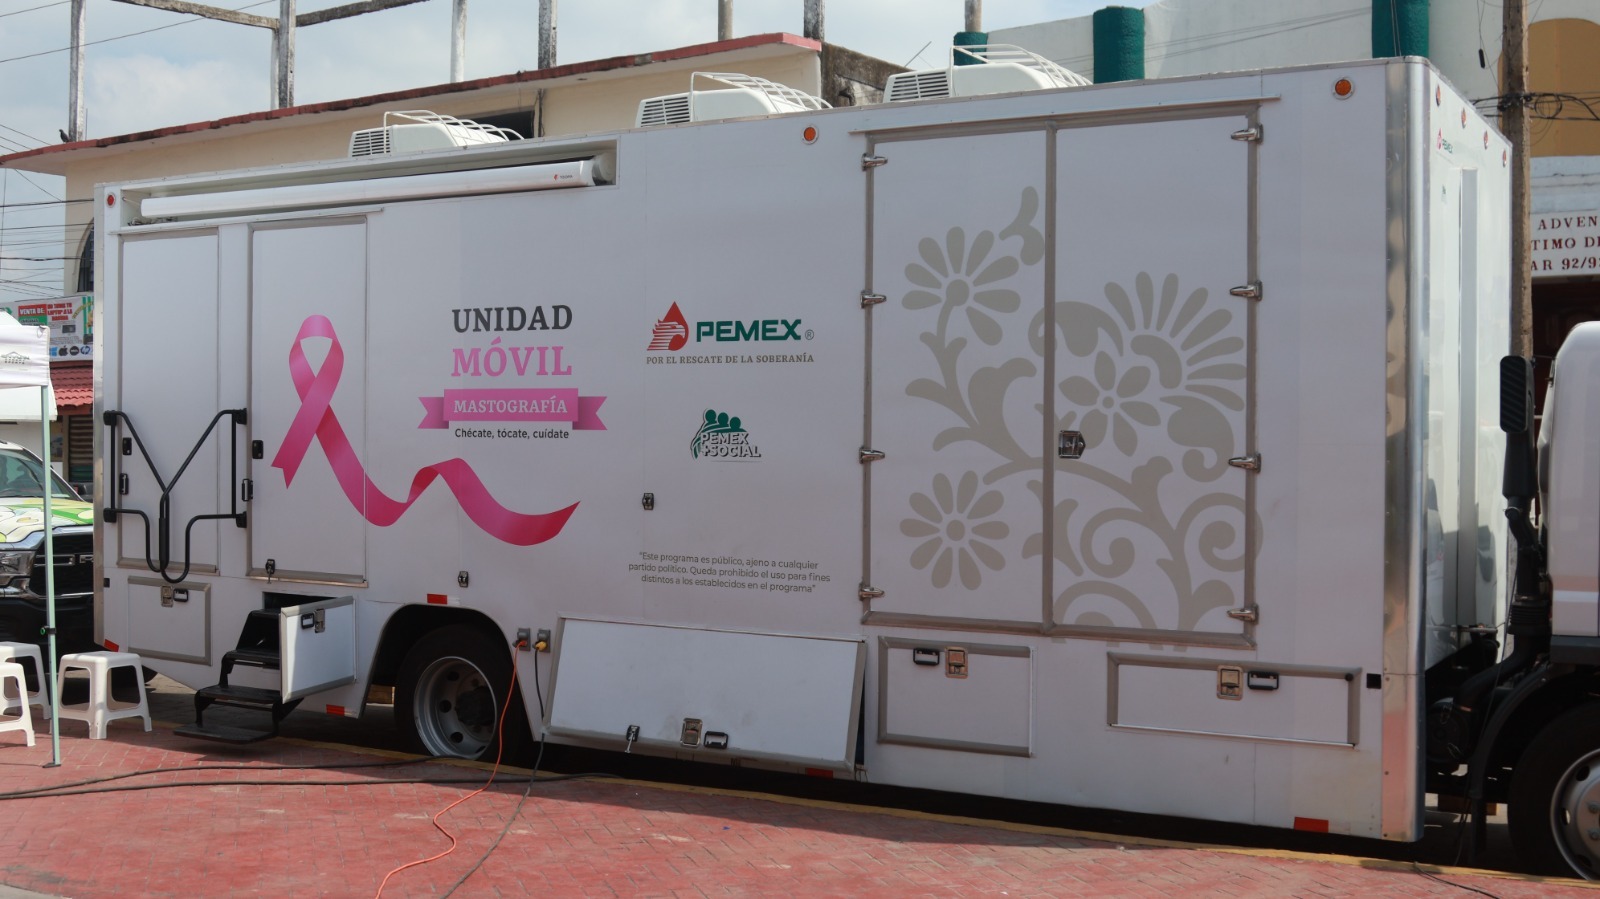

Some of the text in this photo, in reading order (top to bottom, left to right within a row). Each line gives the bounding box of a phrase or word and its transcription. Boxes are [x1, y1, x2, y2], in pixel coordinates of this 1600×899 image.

[1538, 216, 1598, 230] ADVEN
[1562, 256, 1600, 270] 92/9
[20, 307, 36, 315] VENTA
[452, 305, 573, 333] UNIDAD
[697, 319, 802, 342] PEMEX
[451, 335, 572, 377] MÓVIL
[646, 352, 814, 365] POR EL RESCATE DE LA SOBERANÍA
[453, 395, 568, 413] MASTOGRAFÍA
[455, 428, 569, 440] Chécate, tócate, cuídate
[701, 432, 749, 445] PEMEX
[660, 554, 699, 564] programa
[701, 556, 710, 564] es
[712, 556, 745, 566] público,
[746, 558, 770, 568] ajeno
[778, 560, 819, 571] cualquier
[628, 563, 831, 582] partido político. Queda prohibido el uso para fines
[641, 575, 674, 585] distintos
[682, 577, 694, 586] los
[695, 578, 746, 589] establecidos
[747, 582, 759, 590] en
[760, 582, 768, 590] el
